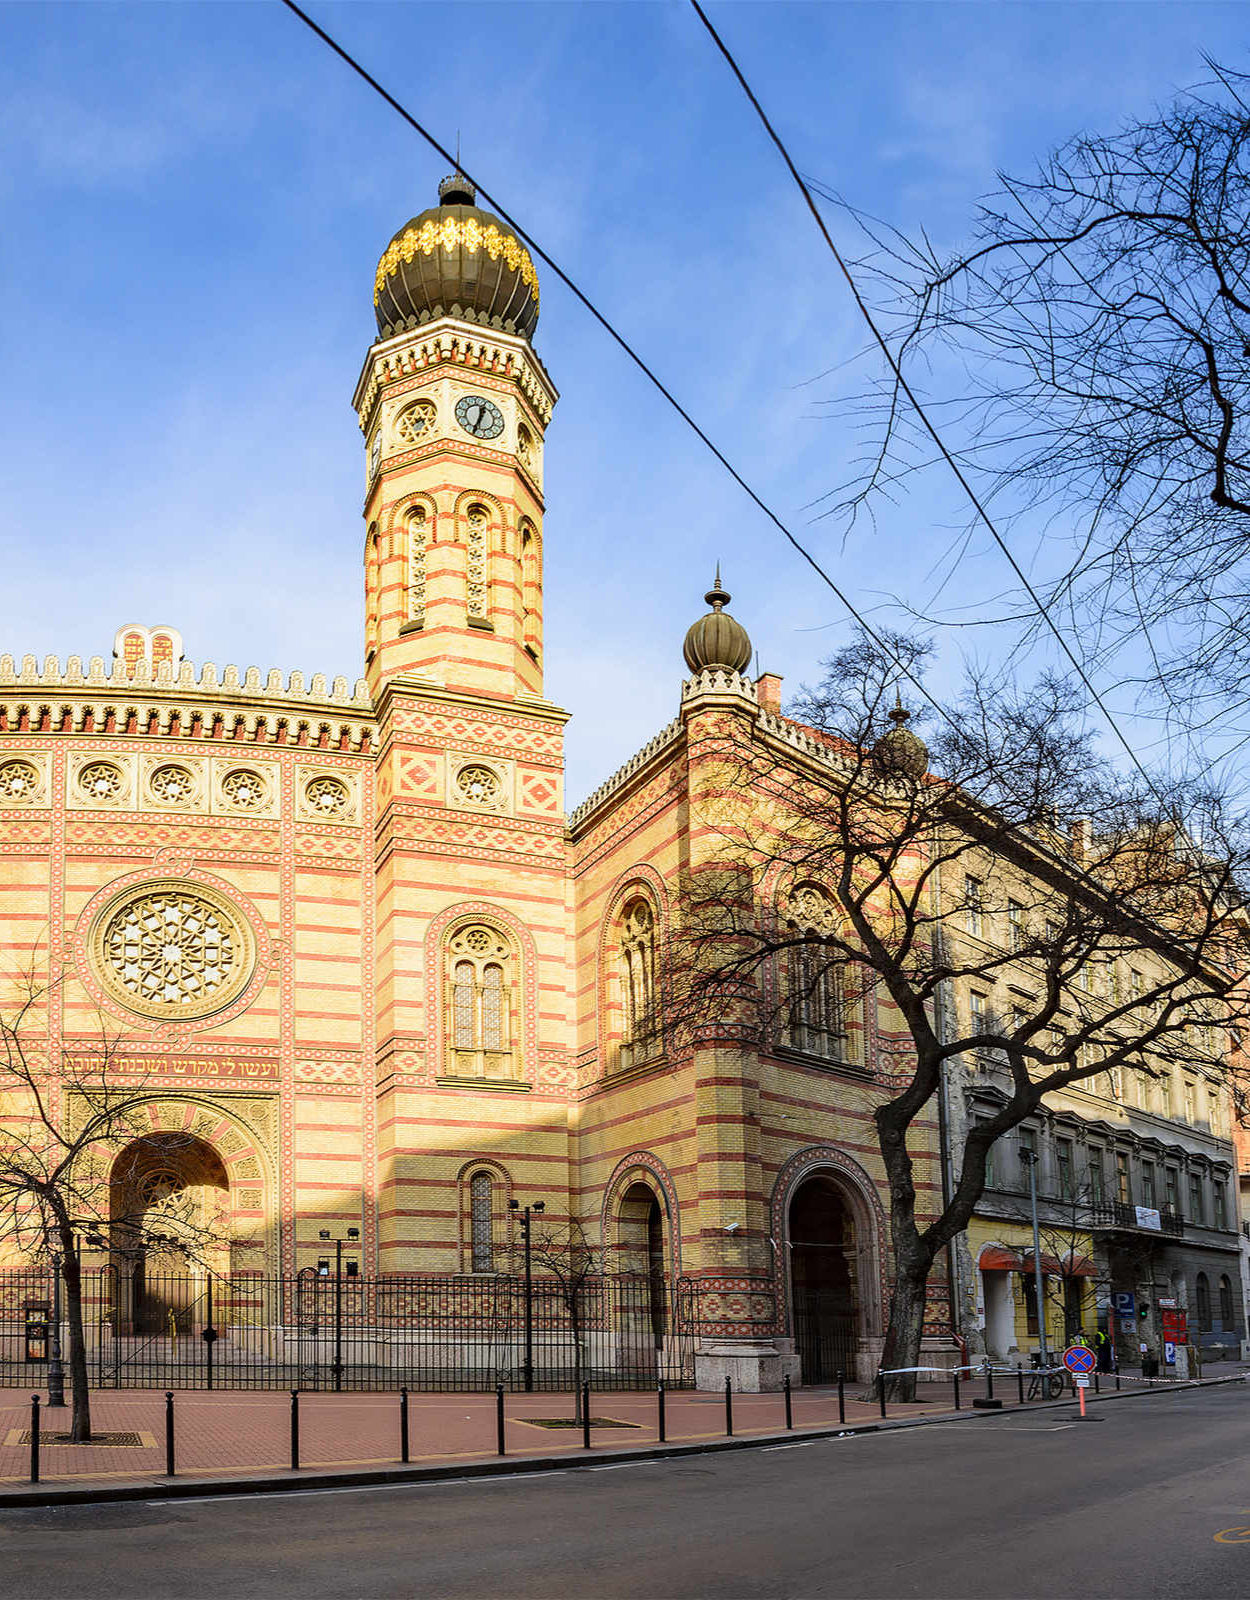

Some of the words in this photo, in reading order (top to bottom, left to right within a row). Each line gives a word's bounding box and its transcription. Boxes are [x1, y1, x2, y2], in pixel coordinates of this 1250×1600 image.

[172, 1059, 219, 1075] מקדש
[222, 1057, 235, 1074] לי
[238, 1061, 279, 1076] ועשו
[1116, 1294, 1129, 1309] P
[1165, 1342, 1173, 1362] P
